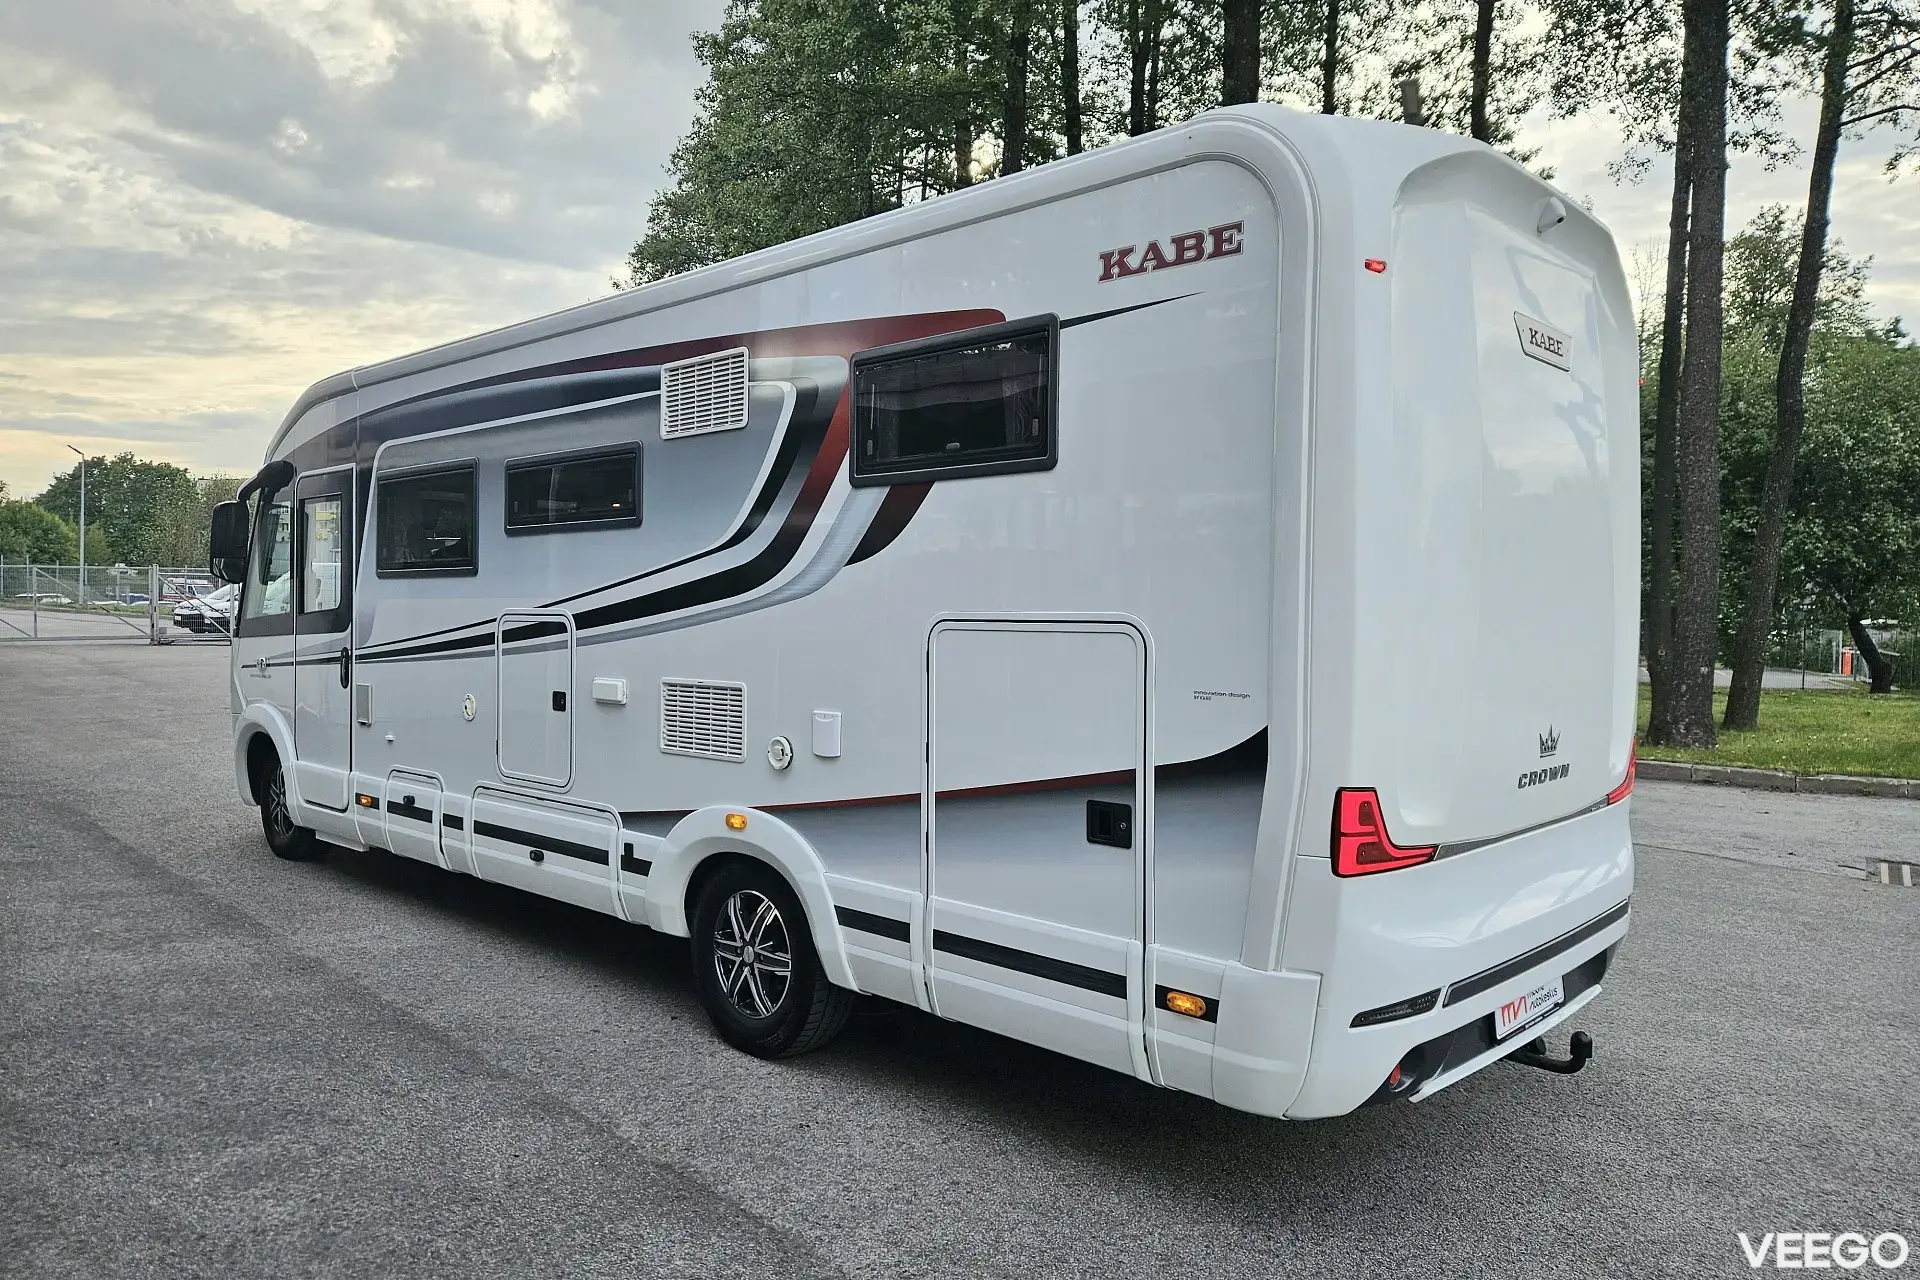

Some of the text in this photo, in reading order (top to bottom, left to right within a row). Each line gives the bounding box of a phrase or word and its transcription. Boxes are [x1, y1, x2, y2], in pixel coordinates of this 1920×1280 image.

[1098, 220, 1244, 283] KABE
[1529, 327, 1563, 357] KABE
[1517, 763, 1570, 789] CROWN
